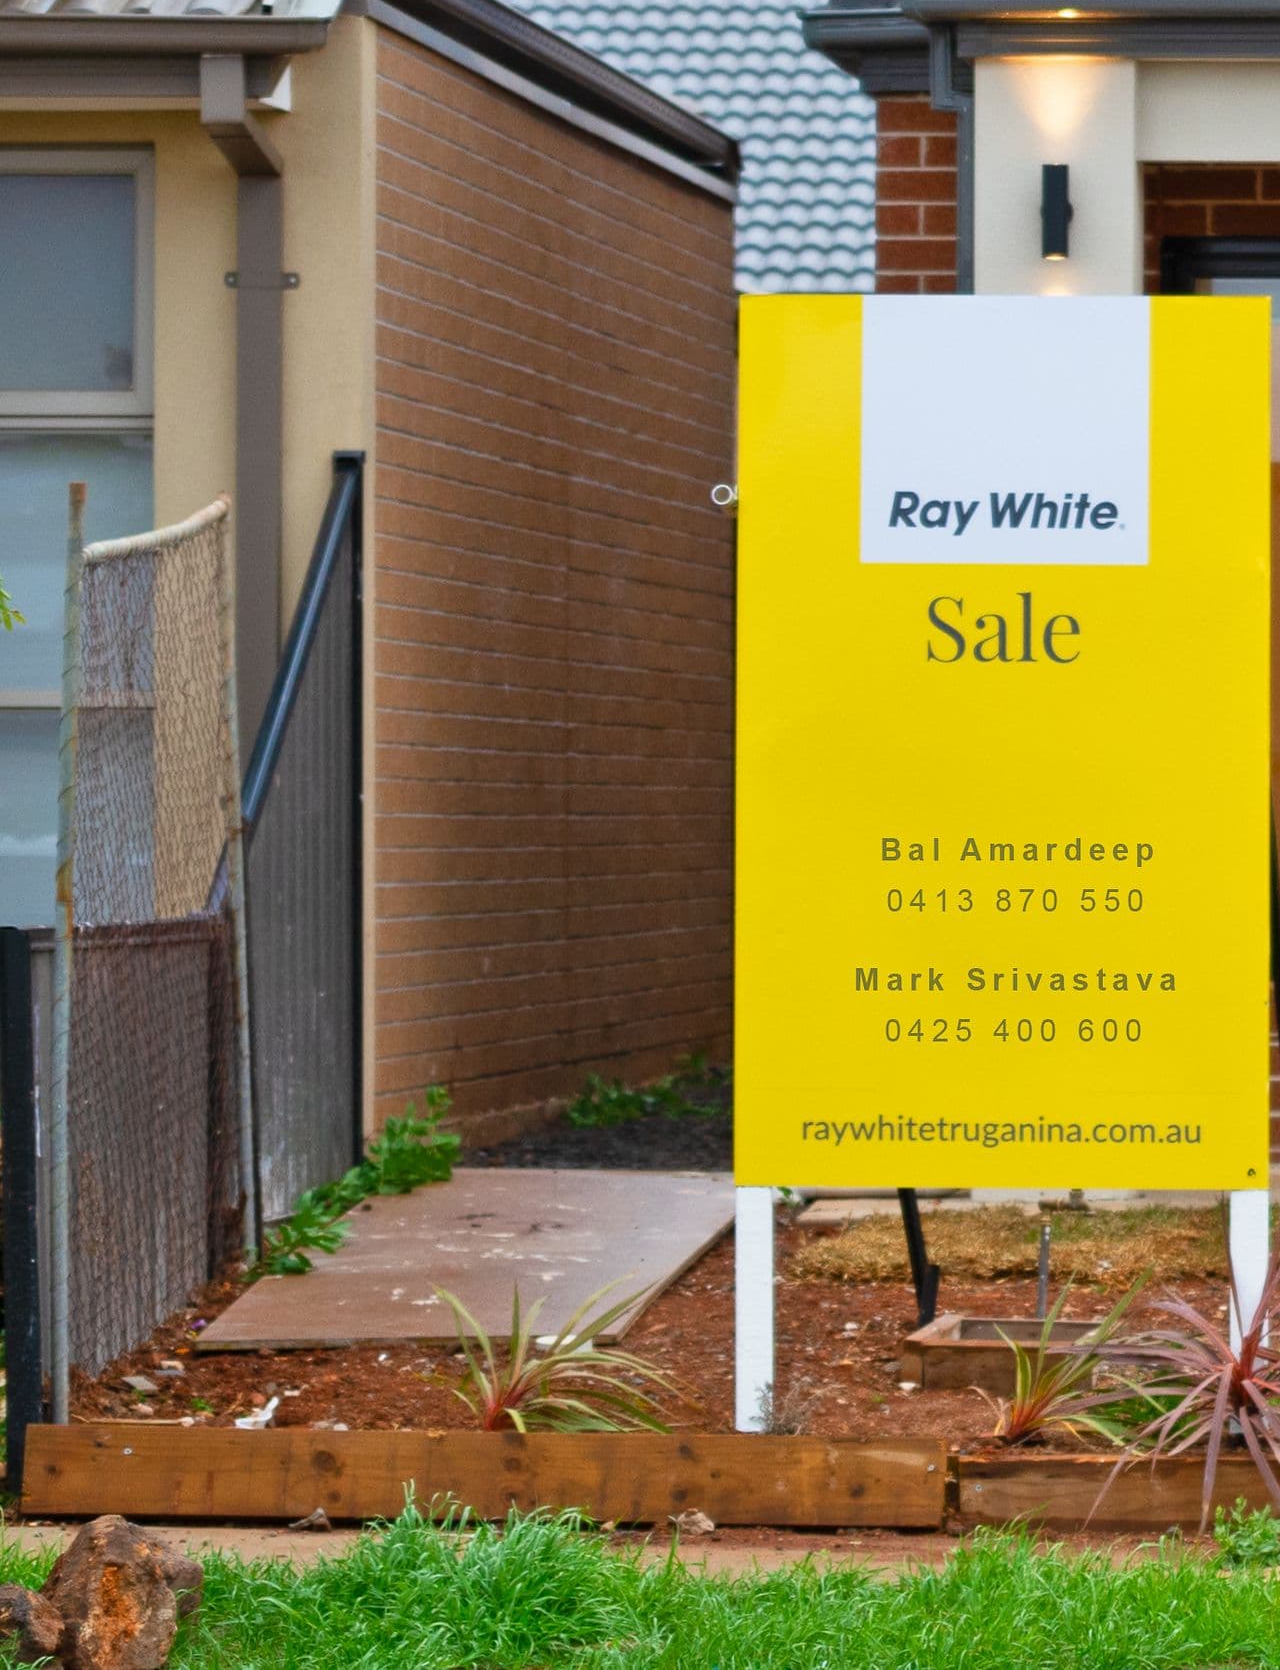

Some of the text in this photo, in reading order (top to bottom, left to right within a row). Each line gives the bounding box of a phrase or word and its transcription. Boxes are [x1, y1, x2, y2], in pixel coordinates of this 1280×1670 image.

[888, 490, 980, 536] Ray
[927, 591, 1081, 664] Sale
[881, 837, 1155, 867] Bal Amardeep
[887, 888, 1144, 913] 0413 870 550
[855, 967, 1177, 992] Mark Srivastava
[885, 1018, 1142, 1043] 0425 400 600
[802, 1114, 1202, 1148] raywhitetruganina.com.au
